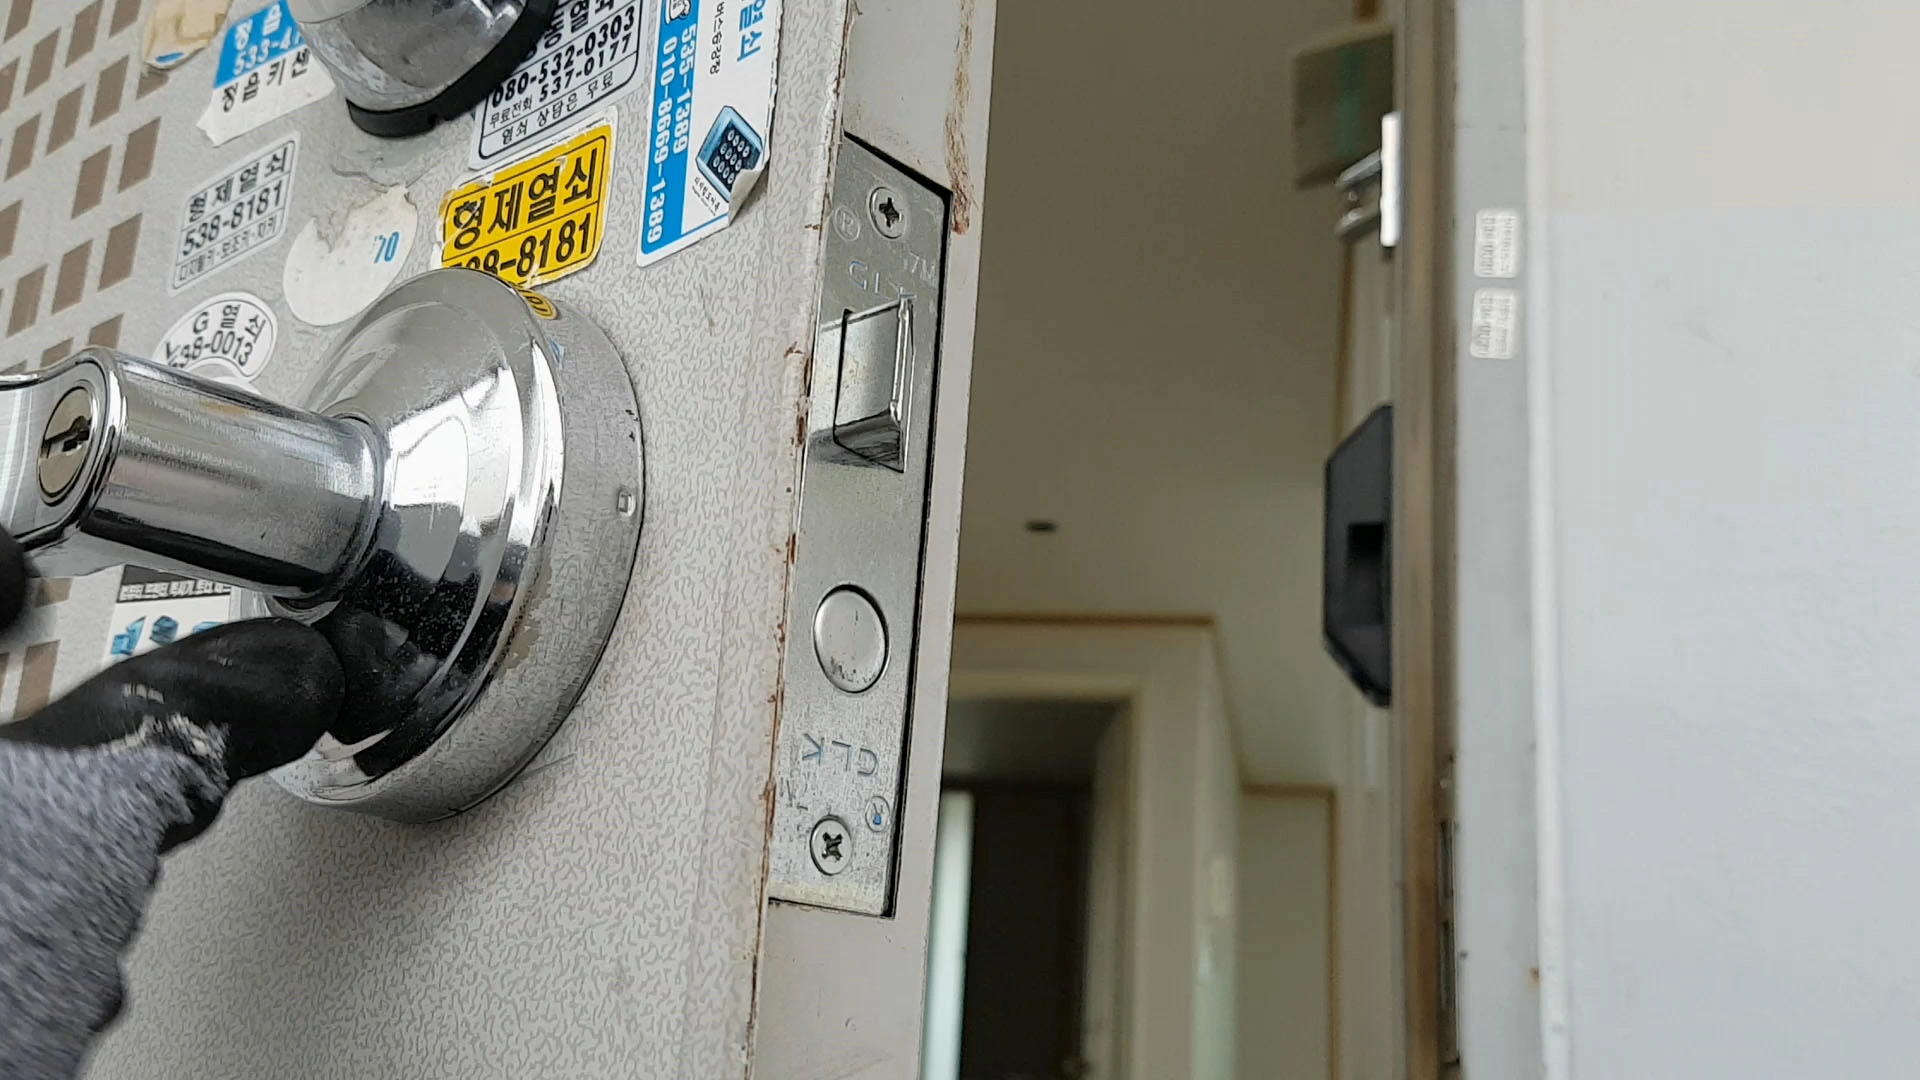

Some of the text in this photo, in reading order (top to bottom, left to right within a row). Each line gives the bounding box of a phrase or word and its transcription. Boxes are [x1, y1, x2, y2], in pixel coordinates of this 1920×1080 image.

[488, 32, 632, 129] 무료전화 537-0177
[491, 5, 635, 108] 080-532-0303
[673, 22, 697, 155] 535-1389
[501, 70, 614, 145] 열쇠 상담은 무료
[647, 36, 678, 245] 010-8669-1389
[182, 180, 283, 256] 538-8181
[449, 212, 592, 278] 8-8181
[453, 148, 598, 250] 형제열쇠
